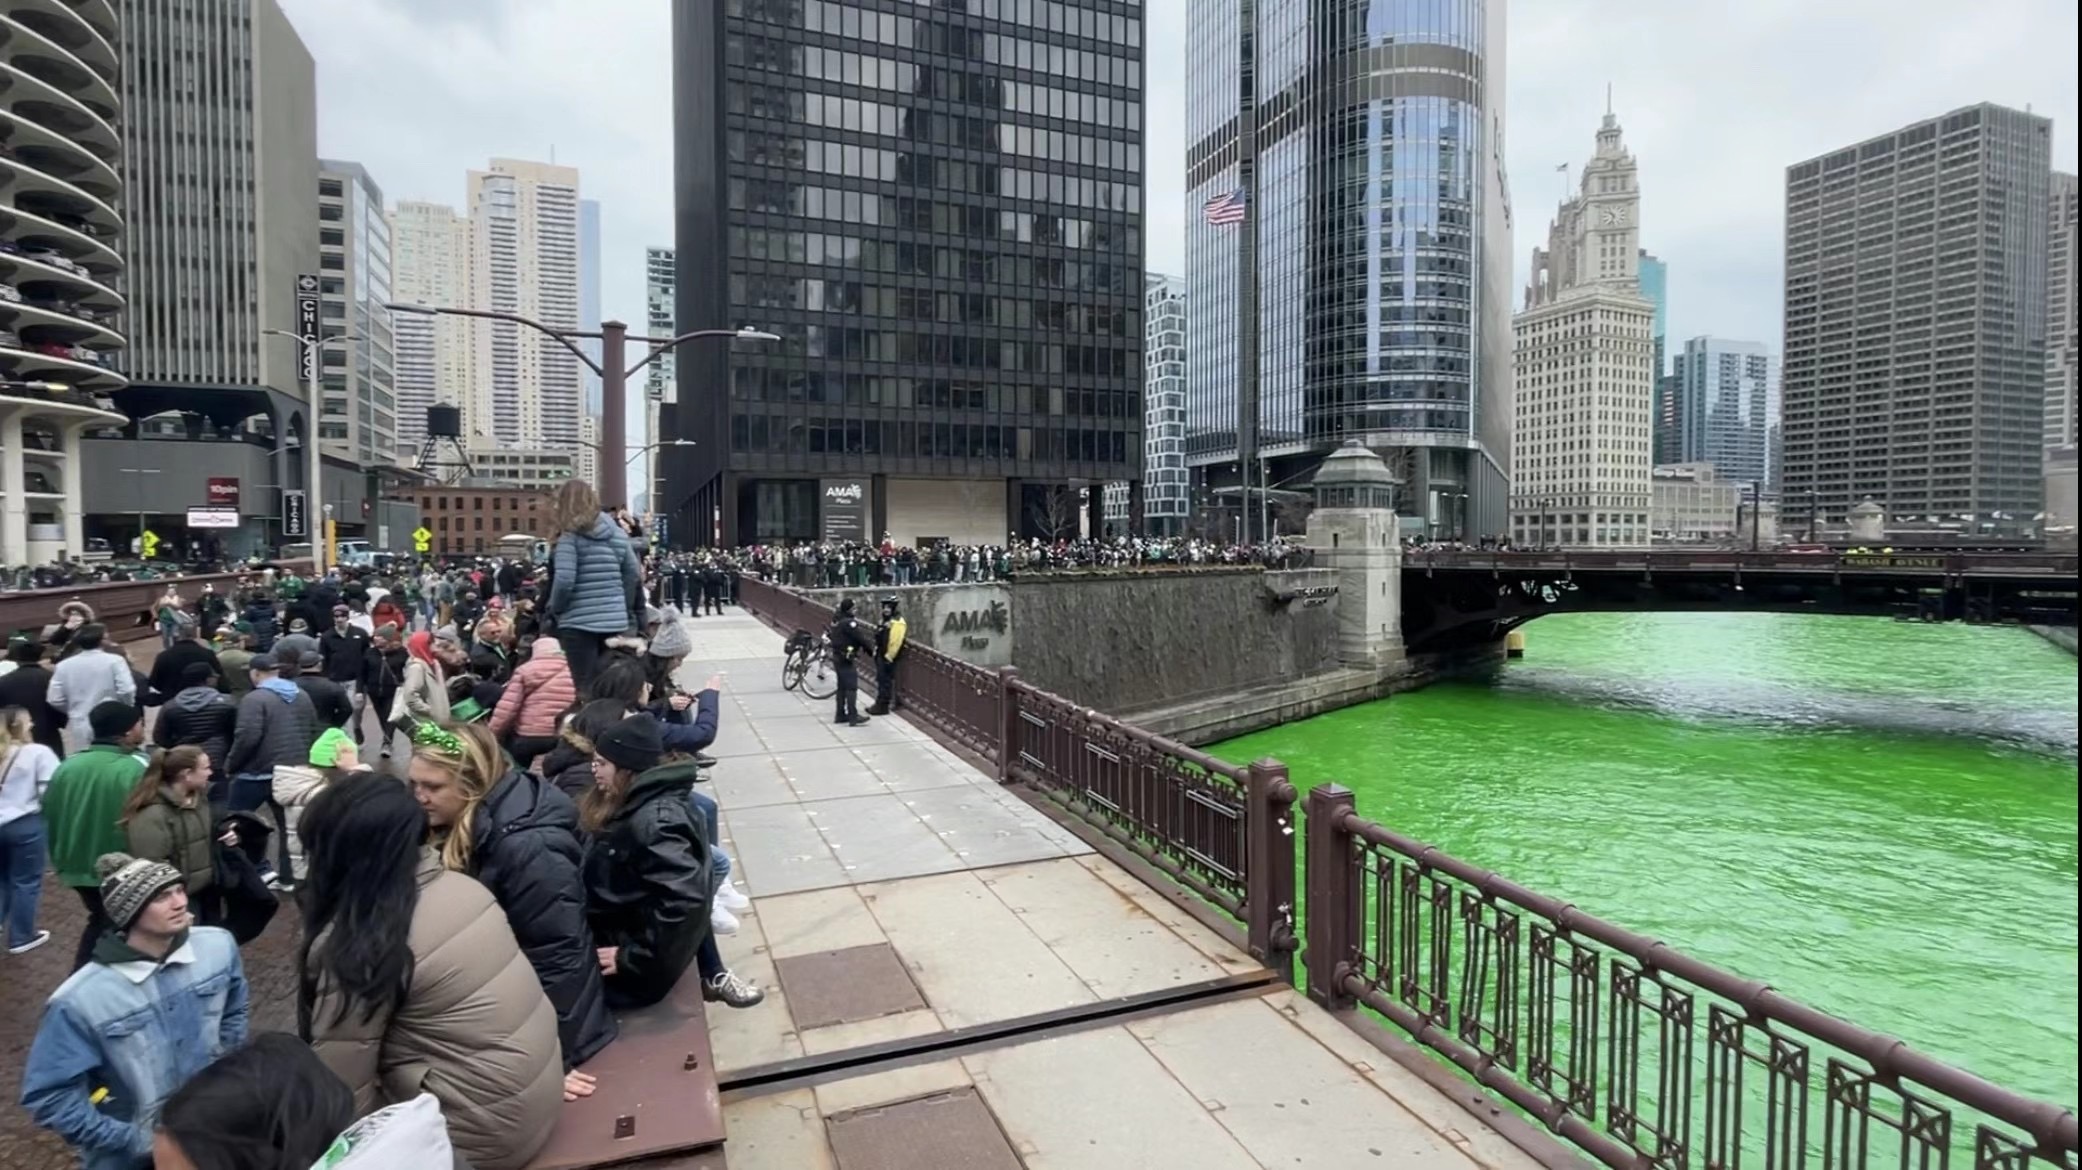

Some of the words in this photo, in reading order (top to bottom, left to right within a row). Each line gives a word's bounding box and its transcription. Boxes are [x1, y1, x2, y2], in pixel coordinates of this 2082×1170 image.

[825, 486, 854, 497] AMA
[290, 495, 299, 534] CHICAGO
[941, 609, 993, 635] AMA
